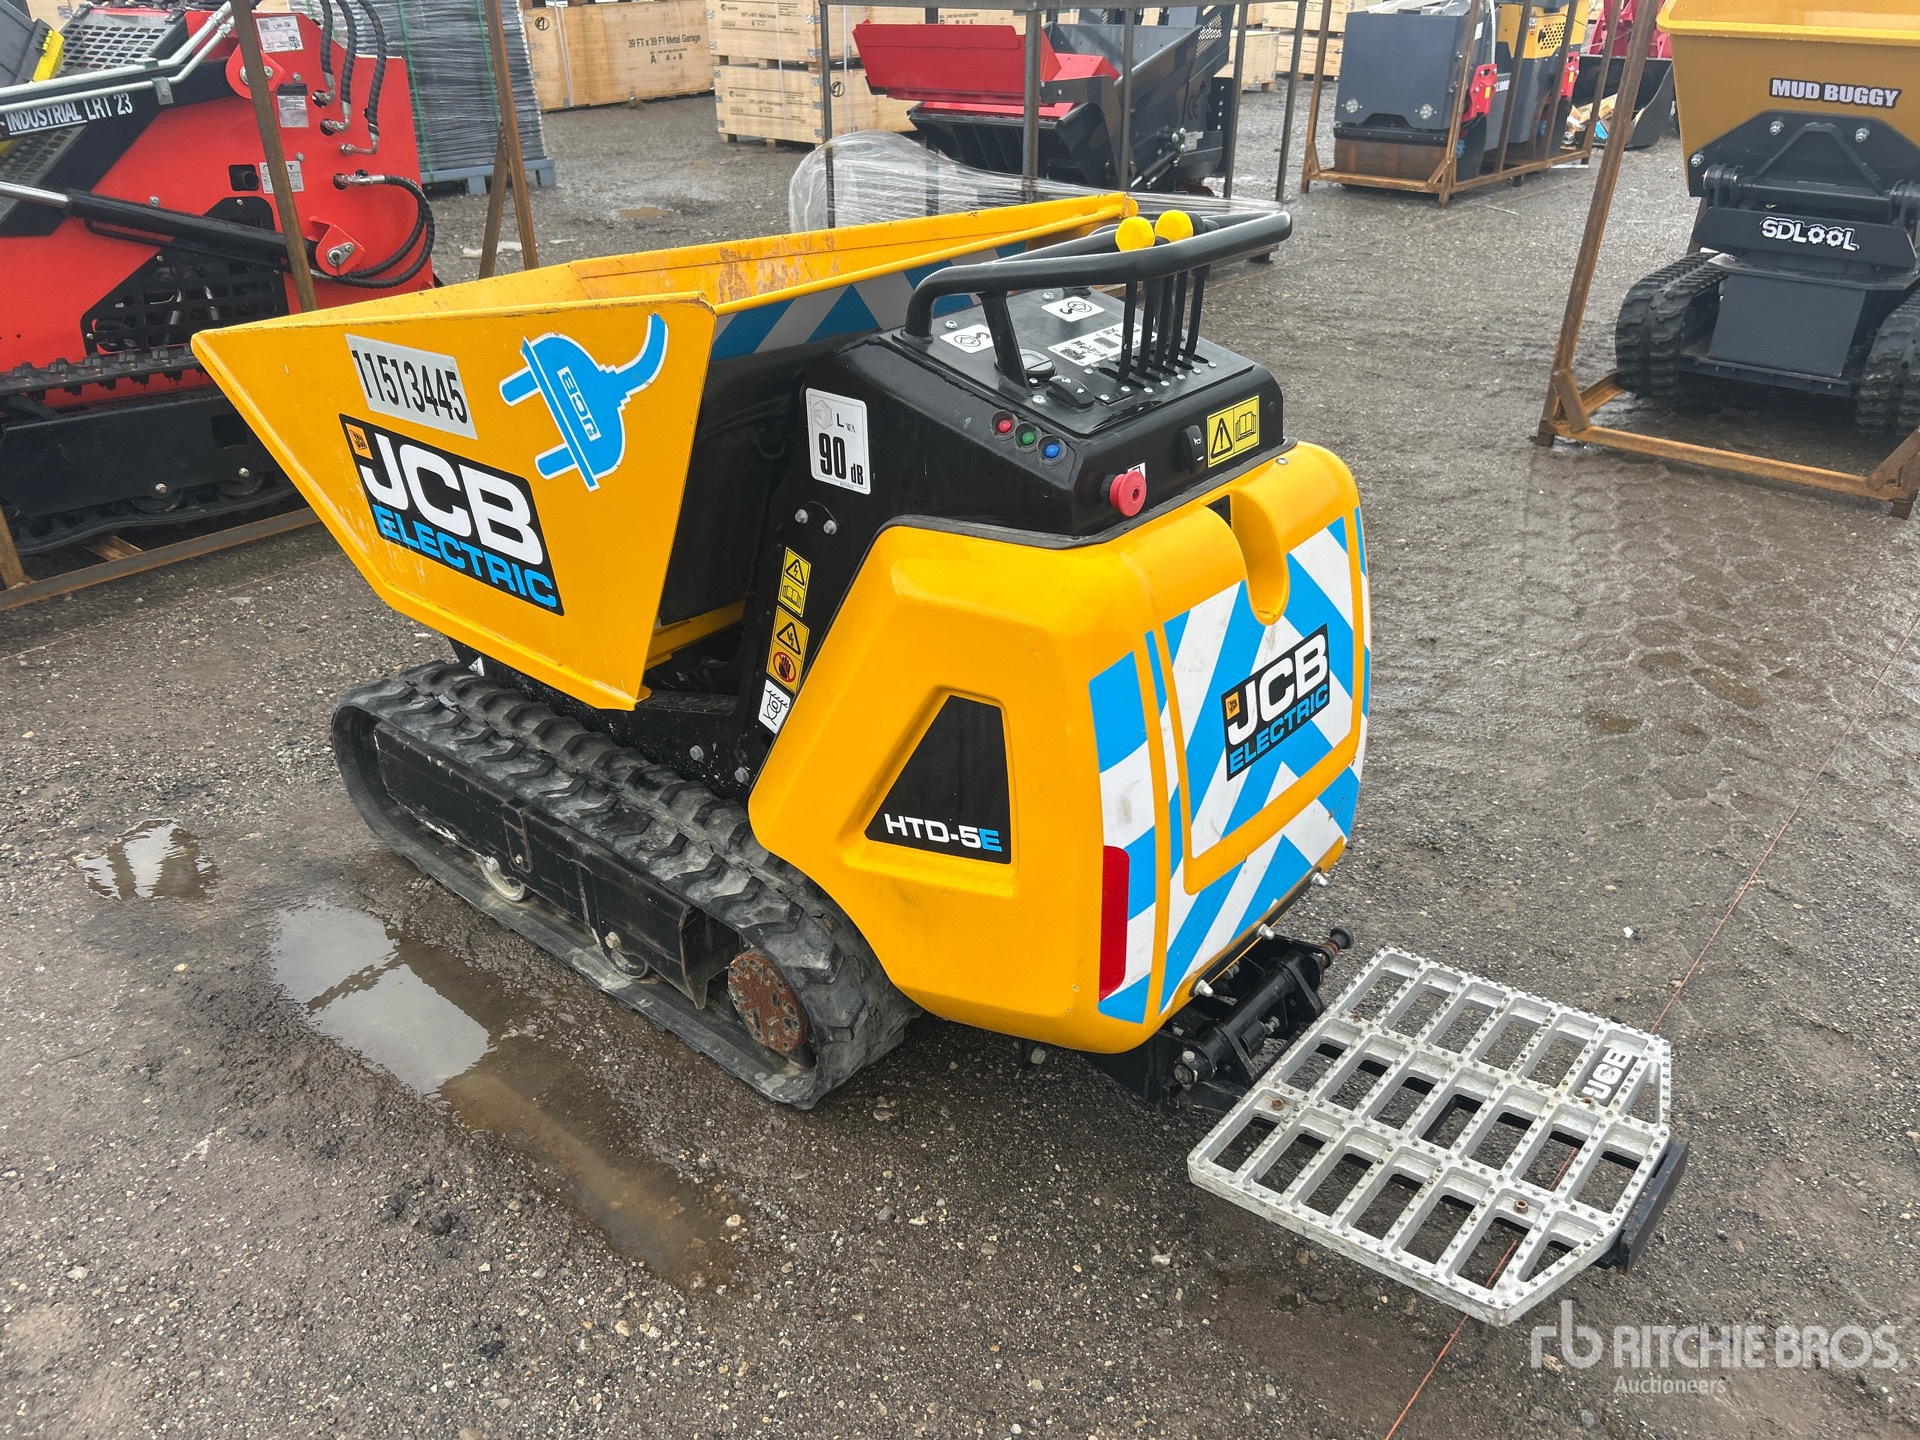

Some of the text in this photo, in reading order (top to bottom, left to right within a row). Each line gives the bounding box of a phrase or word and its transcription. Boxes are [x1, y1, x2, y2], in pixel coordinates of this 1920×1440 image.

[628, 39, 635, 48] 39
[637, 38, 644, 47] FT
[650, 37, 657, 46] 39
[658, 36, 665, 45] FT
[666, 35, 680, 44] Metal
[682, 34, 701, 43] Garage
[5, 93, 133, 131] INDUSTRIAL LRT 23
[1772, 80, 1899, 107] MUD BUGGY
[352, 350, 468, 424] 11513445
[561, 371, 597, 437] JCB
[818, 433, 863, 485] 90 dB
[360, 433, 543, 565] JCB
[372, 504, 558, 608] ELECTRIC
[1228, 634, 1328, 745] JCB
[1229, 683, 1328, 775] ELECTRIC
[884, 813, 1003, 852] HTD-5E
[1582, 1048, 1632, 1099] JCB
